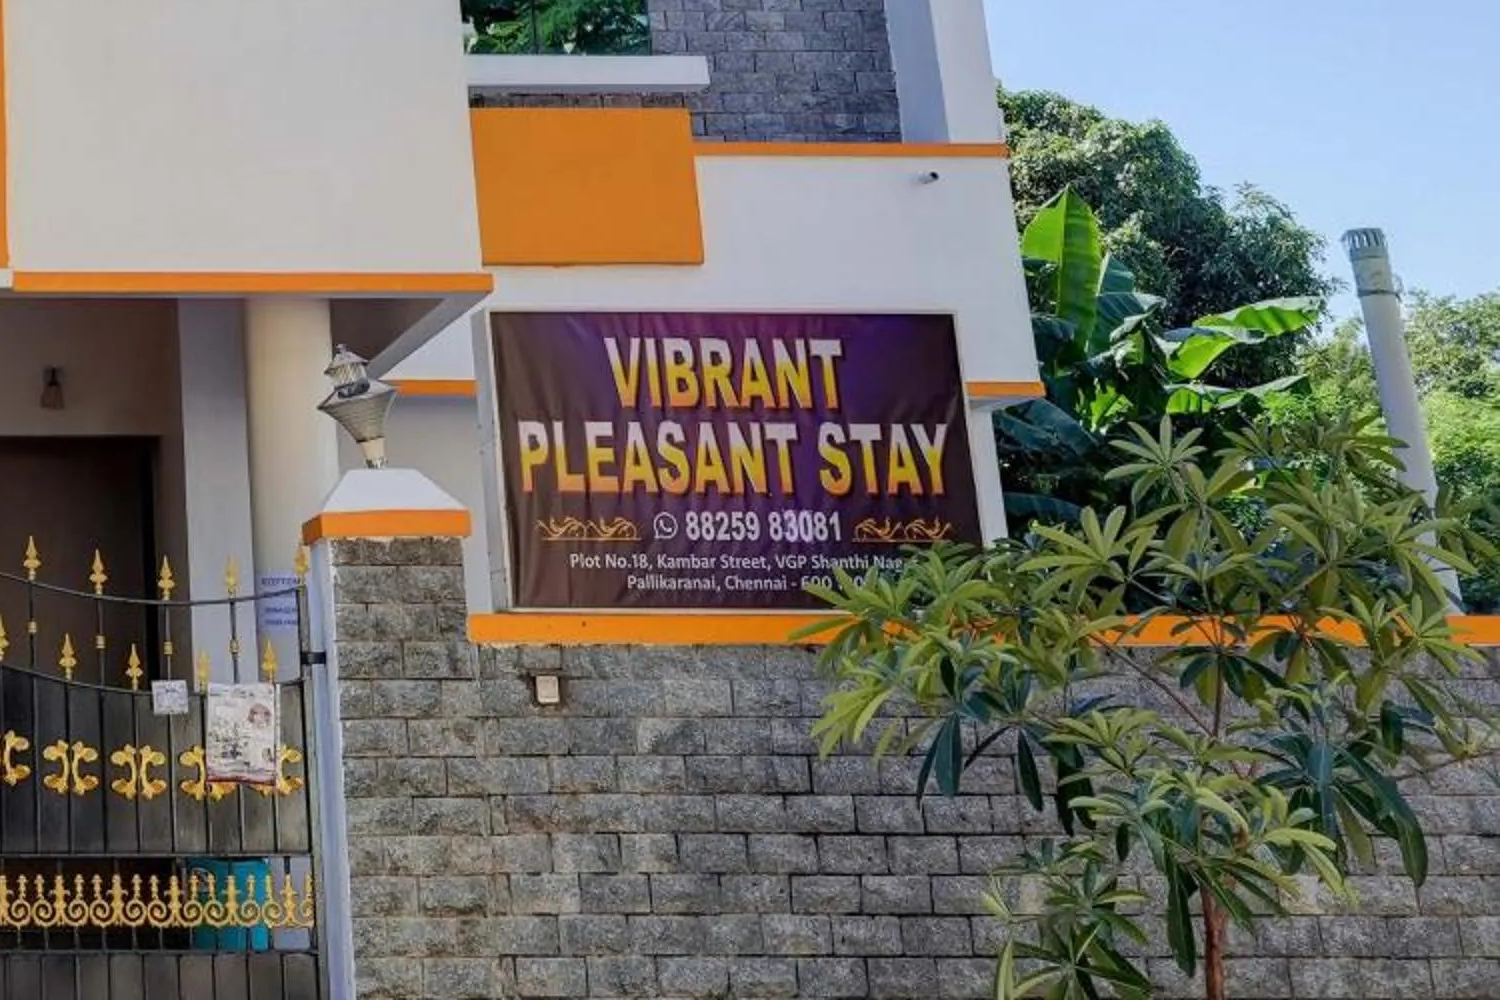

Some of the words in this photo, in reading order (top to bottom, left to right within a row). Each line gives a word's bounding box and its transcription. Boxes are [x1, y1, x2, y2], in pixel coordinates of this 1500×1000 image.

[603, 337, 843, 410] VIBRANT
[518, 421, 798, 495] PLEASANT
[818, 422, 949, 496] STAY
[685, 510, 761, 541] 88259
[768, 509, 842, 543] 83081
[570, 553, 601, 568] Plot
[605, 553, 653, 571] No.18,
[657, 553, 716, 569] Kambar
[720, 554, 771, 571] Street,
[775, 555, 807, 569] VGP
[811, 555, 869, 569] Shanthi
[627, 574, 721, 592] Pallikaranai,
[724, 574, 787, 591] Chennai
